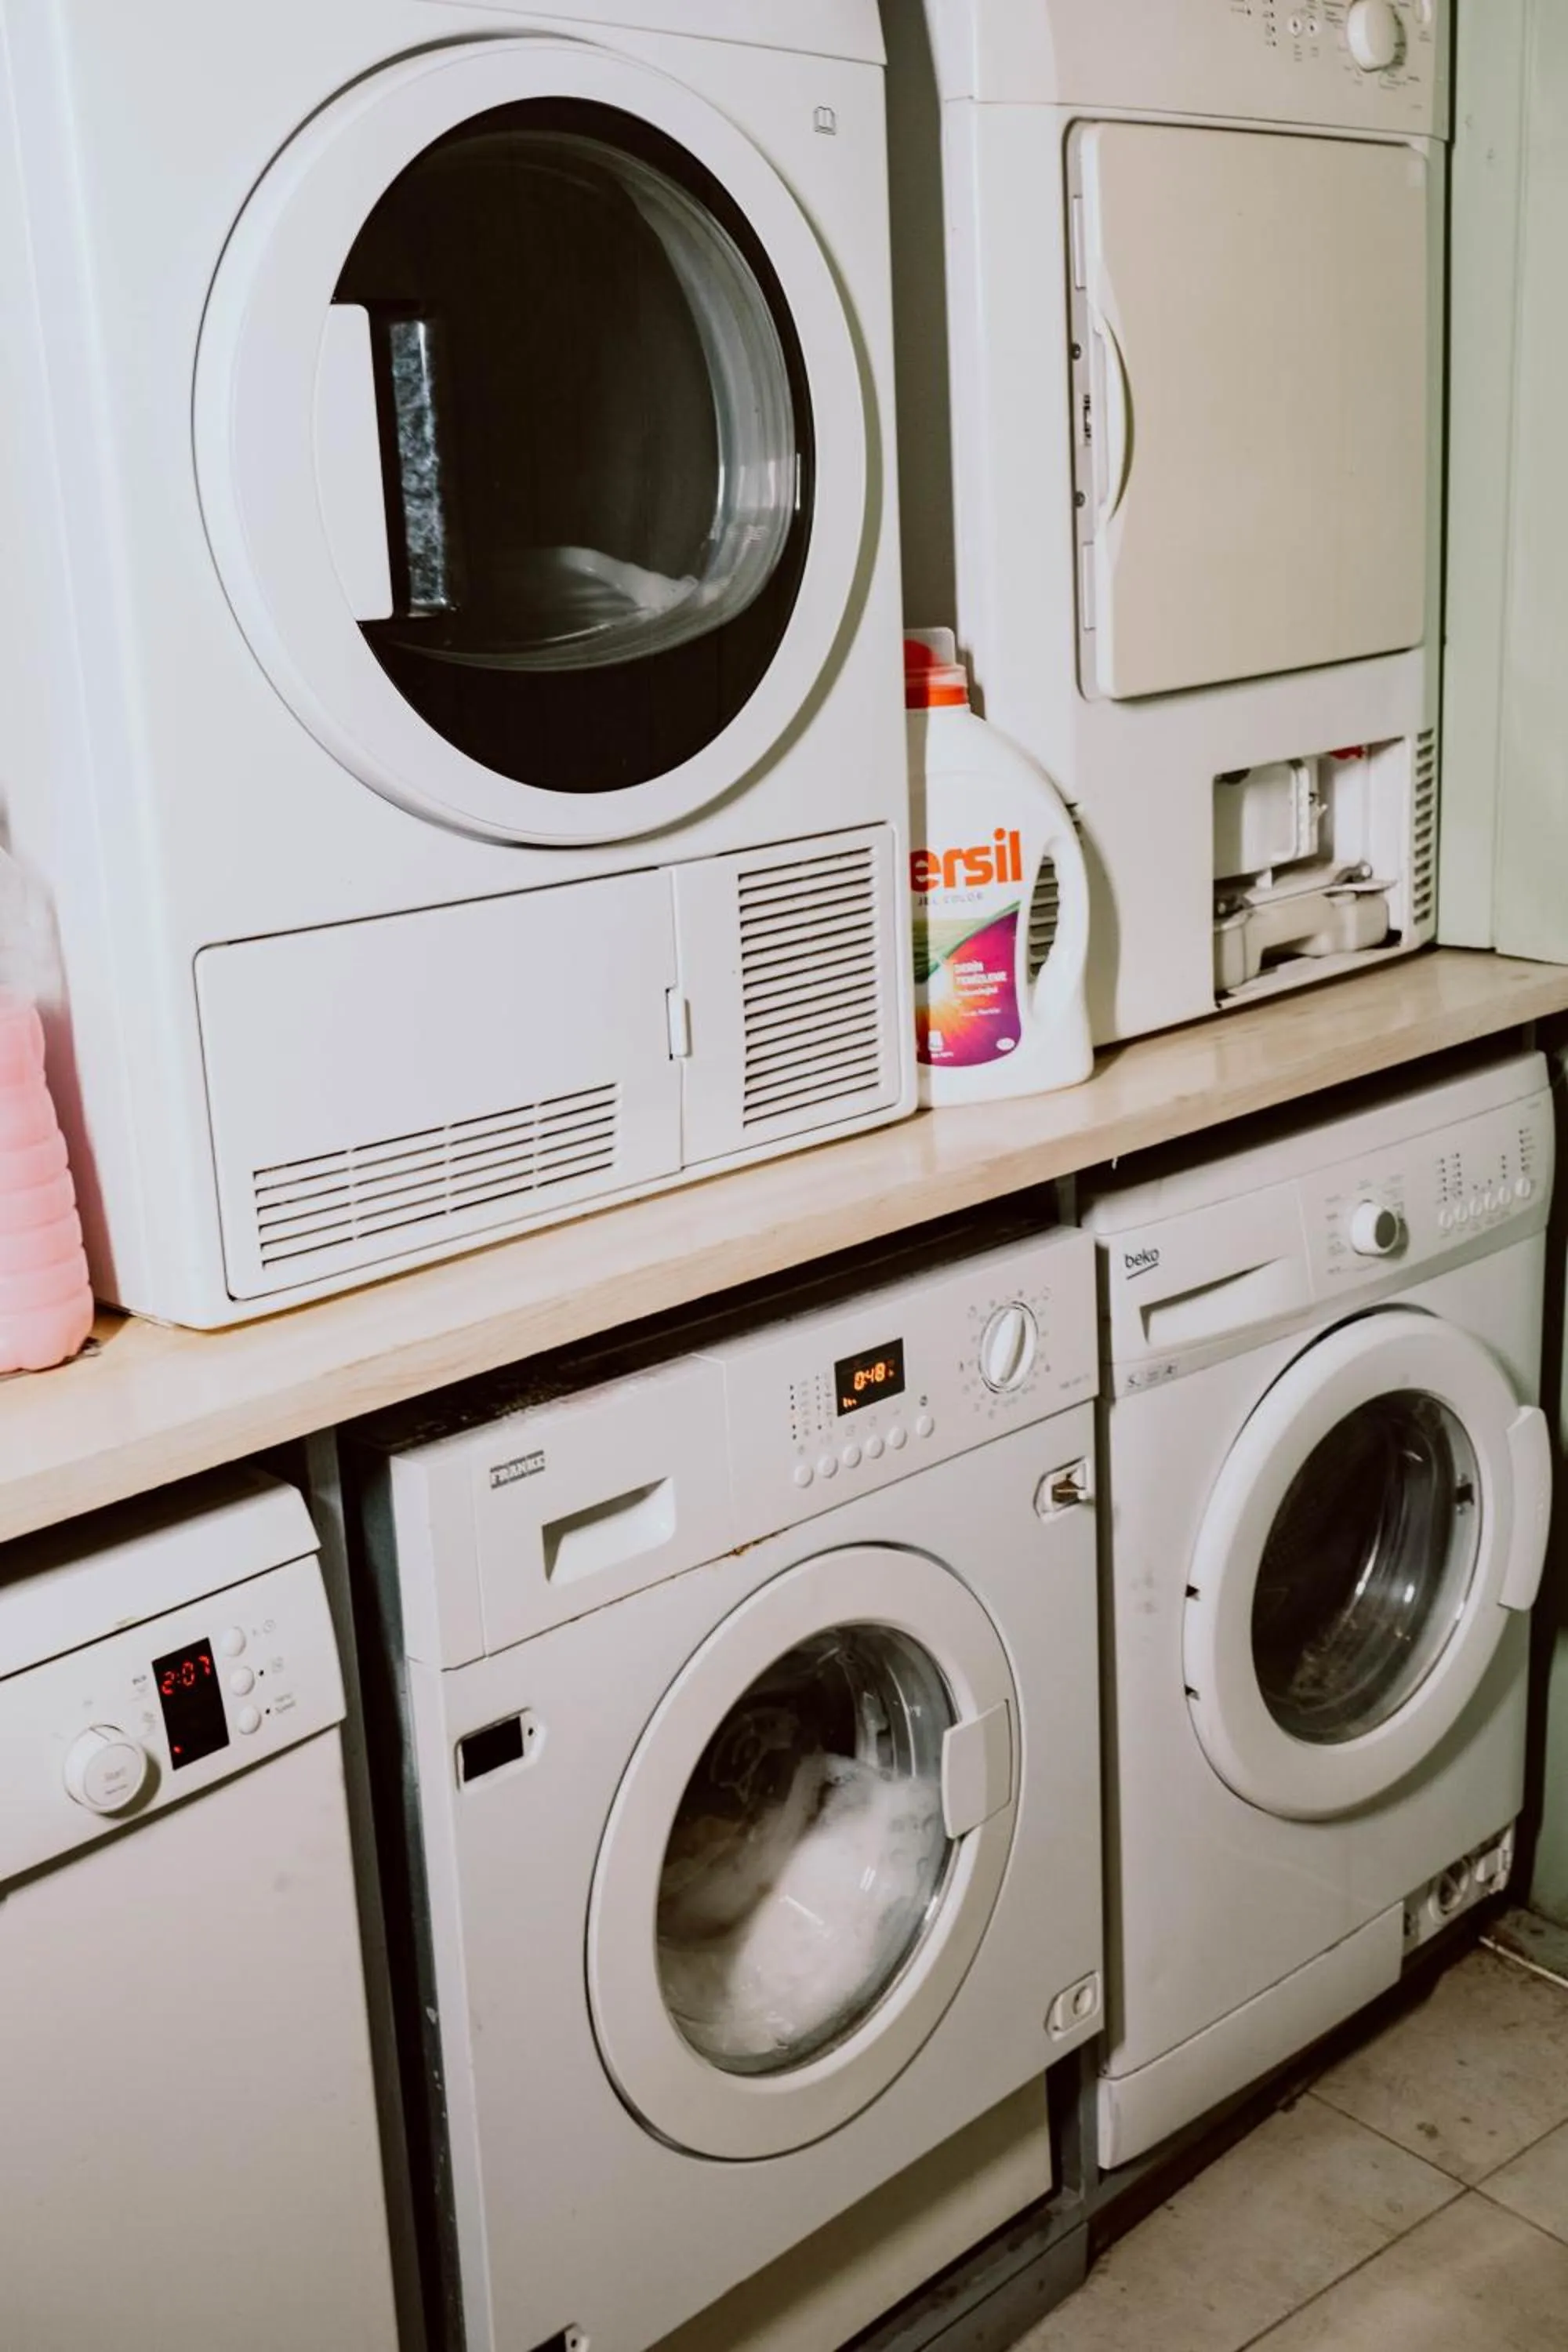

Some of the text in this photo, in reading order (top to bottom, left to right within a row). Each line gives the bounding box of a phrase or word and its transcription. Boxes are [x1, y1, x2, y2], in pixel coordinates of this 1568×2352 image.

[909, 827, 1022, 892] ersil
[1125, 1248, 1160, 1269] beko
[161, 1655, 211, 1695] 2:07
